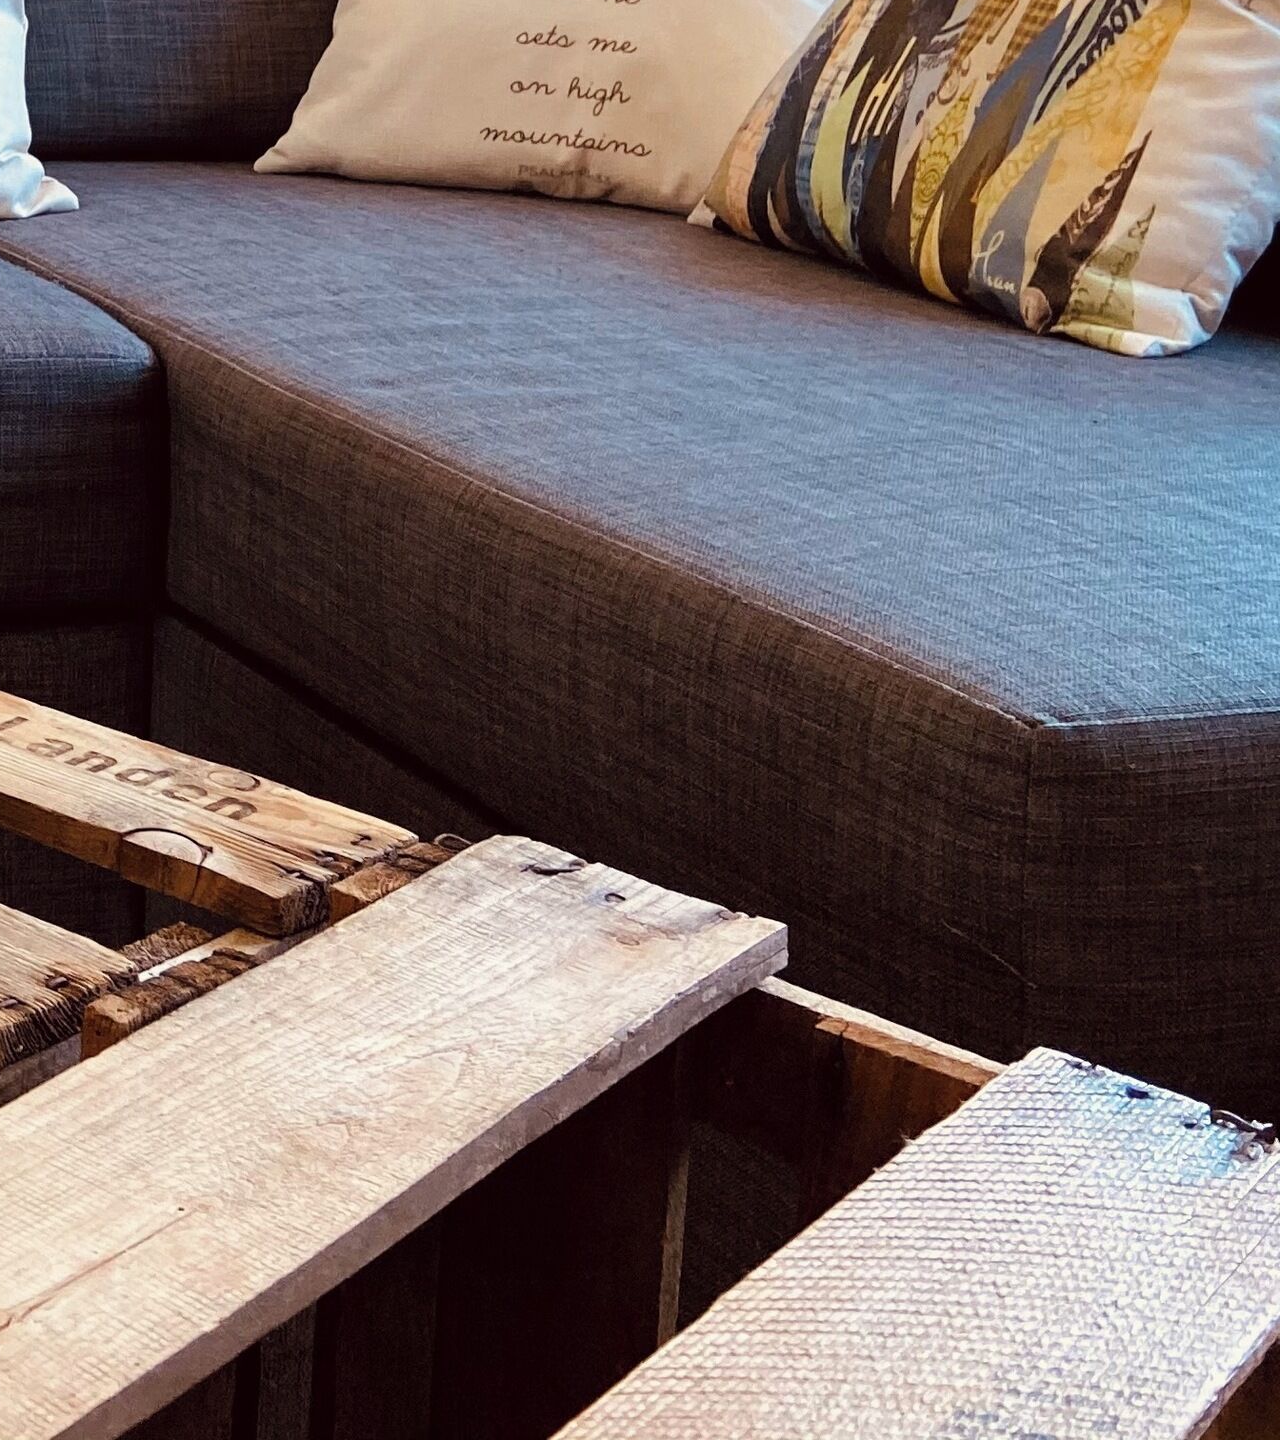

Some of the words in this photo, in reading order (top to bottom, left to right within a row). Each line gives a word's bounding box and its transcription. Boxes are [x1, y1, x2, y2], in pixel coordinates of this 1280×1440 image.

[516, 25, 575, 48] sets
[588, 37, 637, 54] me
[510, 80, 556, 95] on
[567, 76, 631, 116] high
[480, 127, 652, 157] mountains
